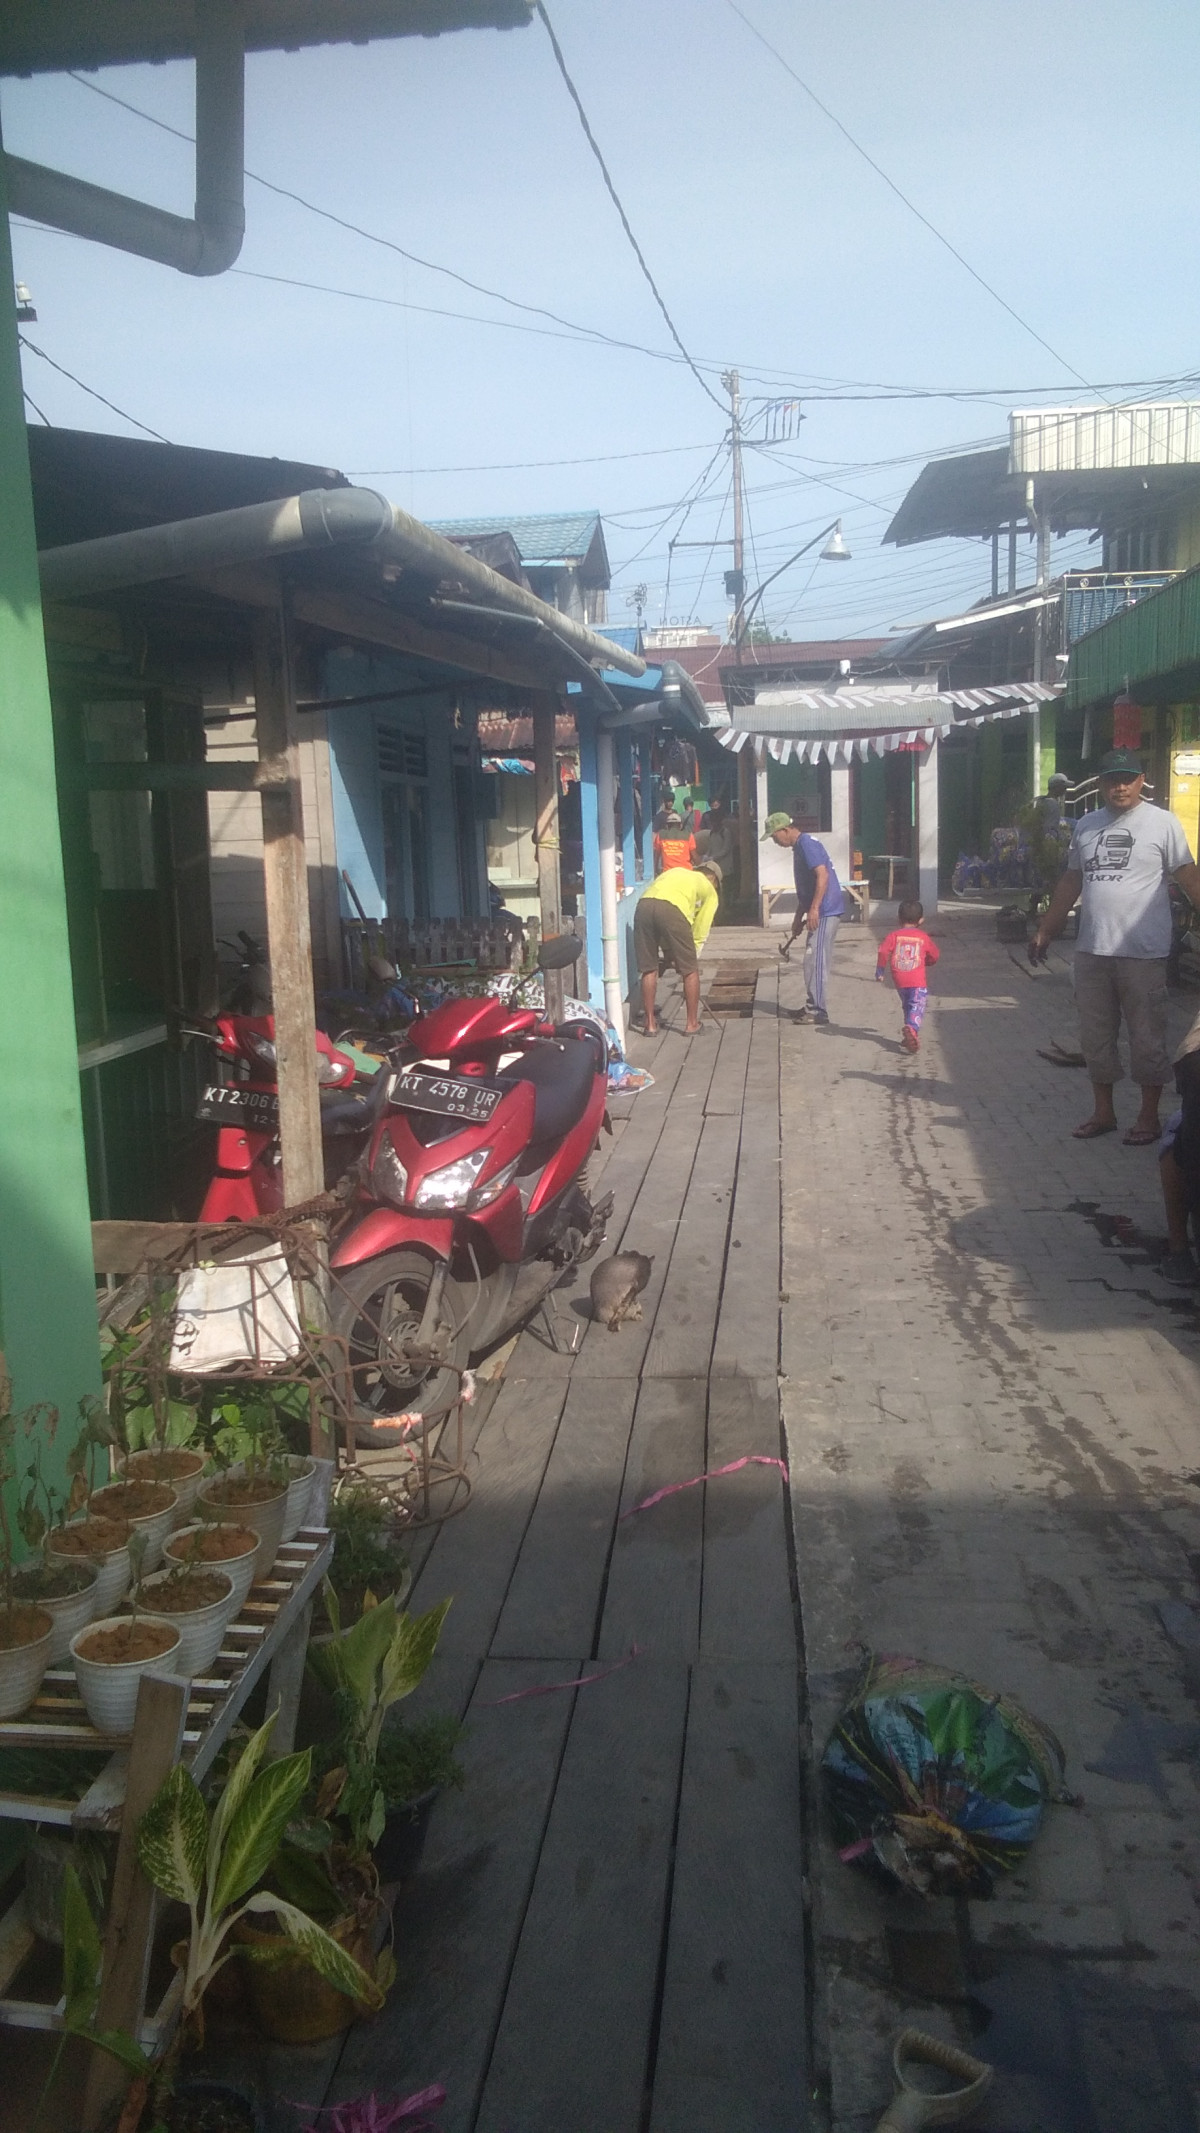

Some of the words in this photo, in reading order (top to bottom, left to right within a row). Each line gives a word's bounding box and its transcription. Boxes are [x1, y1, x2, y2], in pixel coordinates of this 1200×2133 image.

[204, 1087, 228, 1102] KT
[228, 1090, 269, 1108] 2306
[401, 1077, 423, 1090] KT
[429, 1082, 468, 1099] 4578
[474, 1091, 496, 1106] UR
